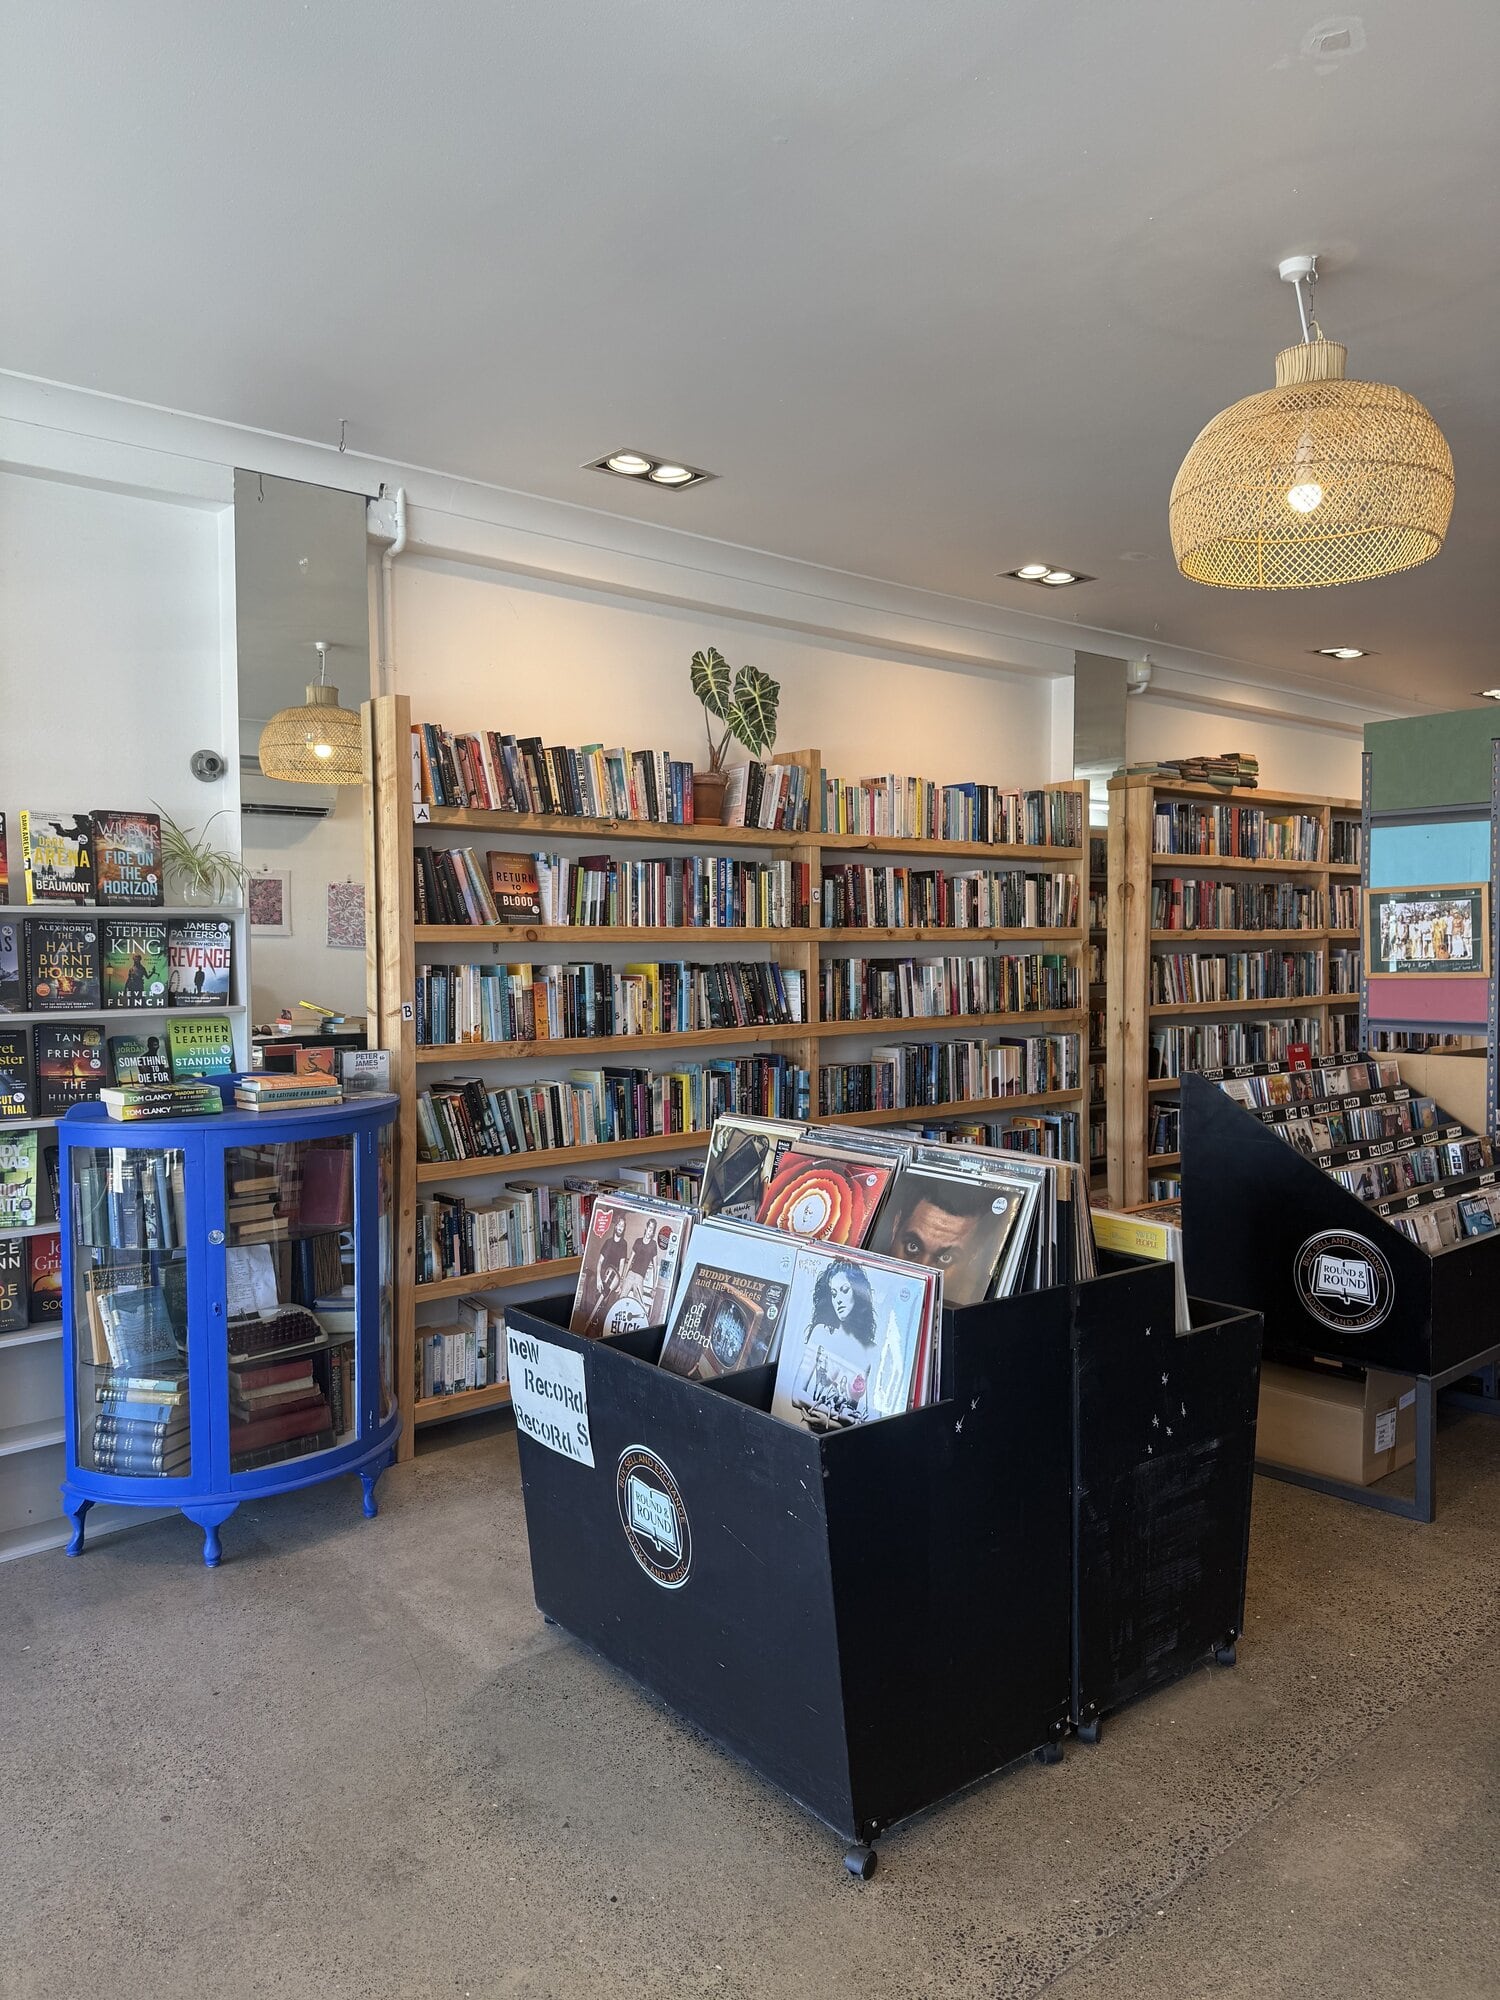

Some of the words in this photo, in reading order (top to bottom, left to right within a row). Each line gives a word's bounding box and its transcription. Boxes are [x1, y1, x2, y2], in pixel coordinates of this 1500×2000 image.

[417, 808, 428, 820] A
[22, 832, 30, 857] ARENA
[38, 836, 65, 847] DARK
[34, 847, 91, 868] ARENA
[105, 850, 134, 865] FIRE
[137, 852, 154, 866] ON
[119, 865, 142, 880] THE
[417, 863, 425, 887] MONICA
[496, 871, 535, 884] RETURN
[36, 879, 91, 893] BEAUMONT
[103, 880, 158, 896] HORIZON
[503, 895, 533, 907] BLOOD
[813, 890, 819, 901] C
[105, 925, 167, 938] STEPHEN
[183, 922, 217, 931] JAMES
[170, 930, 230, 939] PATTERSON
[46, 941, 84, 952] HALF
[111, 938, 162, 955] KING
[40, 954, 92, 966] BURNT
[168, 946, 231, 970] REVENGE
[38, 967, 94, 979] HOUSE
[107, 998, 164, 1007] FLINCH
[403, 1005, 413, 1018] B
[174, 1025, 229, 1034] STEPHEN
[175, 1035, 229, 1044] LEATHER
[47, 1049, 100, 1058] FRENCH
[116, 1046, 146, 1054] JORDAN
[189, 1047, 217, 1056] STILL
[118, 1055, 168, 1068] SOMETHING
[175, 1056, 232, 1066] STANDING
[355, 1059, 379, 1067] JAMES
[138, 1073, 152, 1083] DIE
[153, 1071, 169, 1082] FOR
[63, 1081, 87, 1090] THE
[48, 1093, 101, 1102] HUNTER
[128, 1095, 145, 1103] TOM
[145, 1093, 173, 1101] CLANCY
[174, 1089, 195, 1097] SHADOW
[3, 1104, 27, 1115] TRIAL
[125, 1107, 142, 1117] TOM
[143, 1106, 172, 1115] CLANCY
[1135, 1230, 1157, 1240] SWEET
[1135, 1238, 1158, 1248] PEOPLE
[1312, 1239, 1331, 1251] SELL
[1331, 1237, 1350, 1245] AND
[1350, 1240, 1386, 1279] EXCHANGE
[1323, 1264, 1357, 1277] ROUND
[1358, 1270, 1365, 1279] &
[695, 1278, 710, 1288] and
[711, 1281, 726, 1292] the
[698, 1268, 732, 1283] BUDDY
[732, 1276, 766, 1292] HOLLY
[1323, 1274, 1366, 1290] ROUND
[690, 1302, 707, 1318] off
[1305, 1292, 1330, 1319] BOOKS
[1334, 1317, 1354, 1326] AND
[1356, 1305, 1381, 1325] MUSIC
[614, 1311, 627, 1321] THE
[684, 1313, 701, 1328] the
[677, 1325, 712, 1349] record
[625, 1456, 638, 1469] SELL
[637, 1453, 653, 1467] AND
[654, 1463, 687, 1524] EXCHANGE
[635, 1490, 663, 1514] ROUND
[663, 1507, 670, 1519] &
[636, 1503, 672, 1534] ROUND
[624, 1524, 648, 1568] BOOKS
[650, 1566, 667, 1581] AND
[667, 1560, 688, 1583] MUSIC
